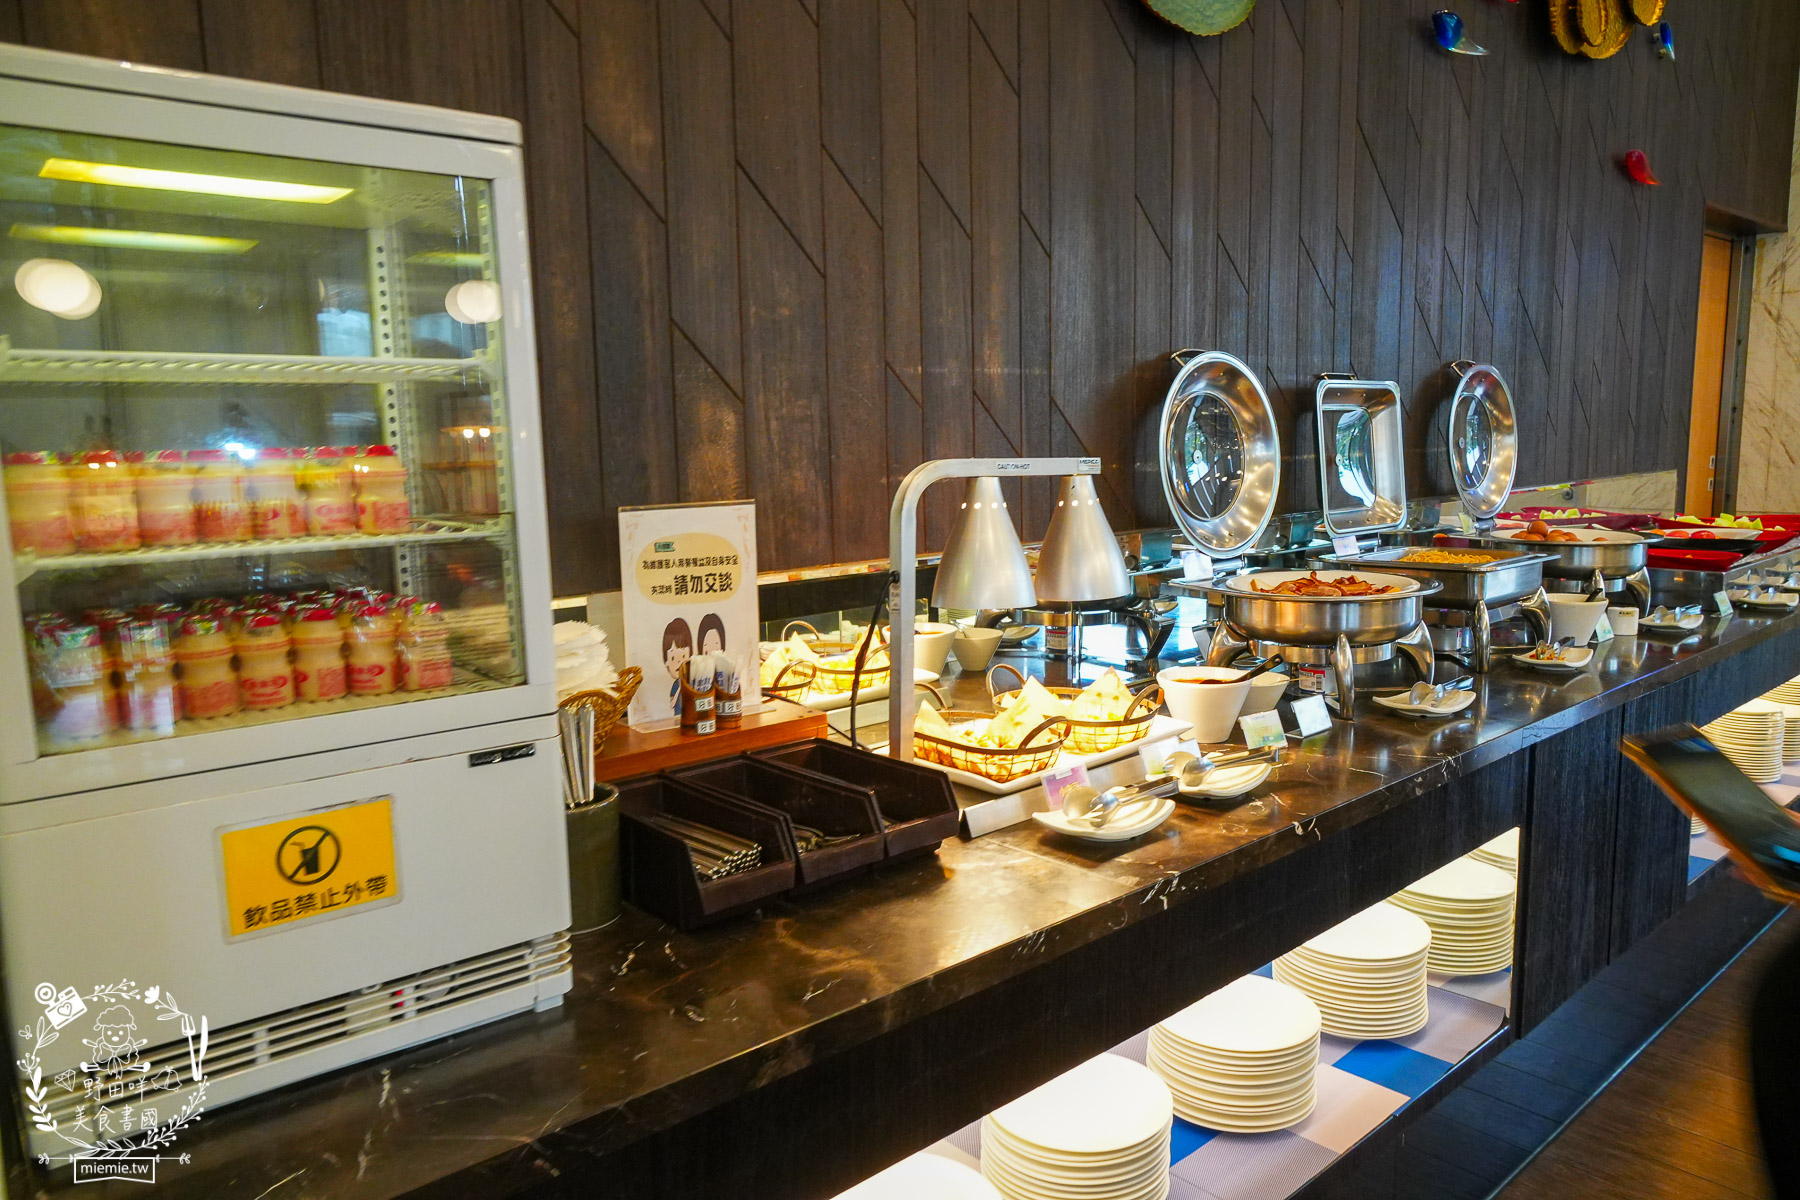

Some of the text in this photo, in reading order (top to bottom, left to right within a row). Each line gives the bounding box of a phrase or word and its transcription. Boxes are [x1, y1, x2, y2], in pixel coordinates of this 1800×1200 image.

[673, 571, 733, 596] 請勿交談
[242, 874, 389, 930] 飲品禁止外帶
